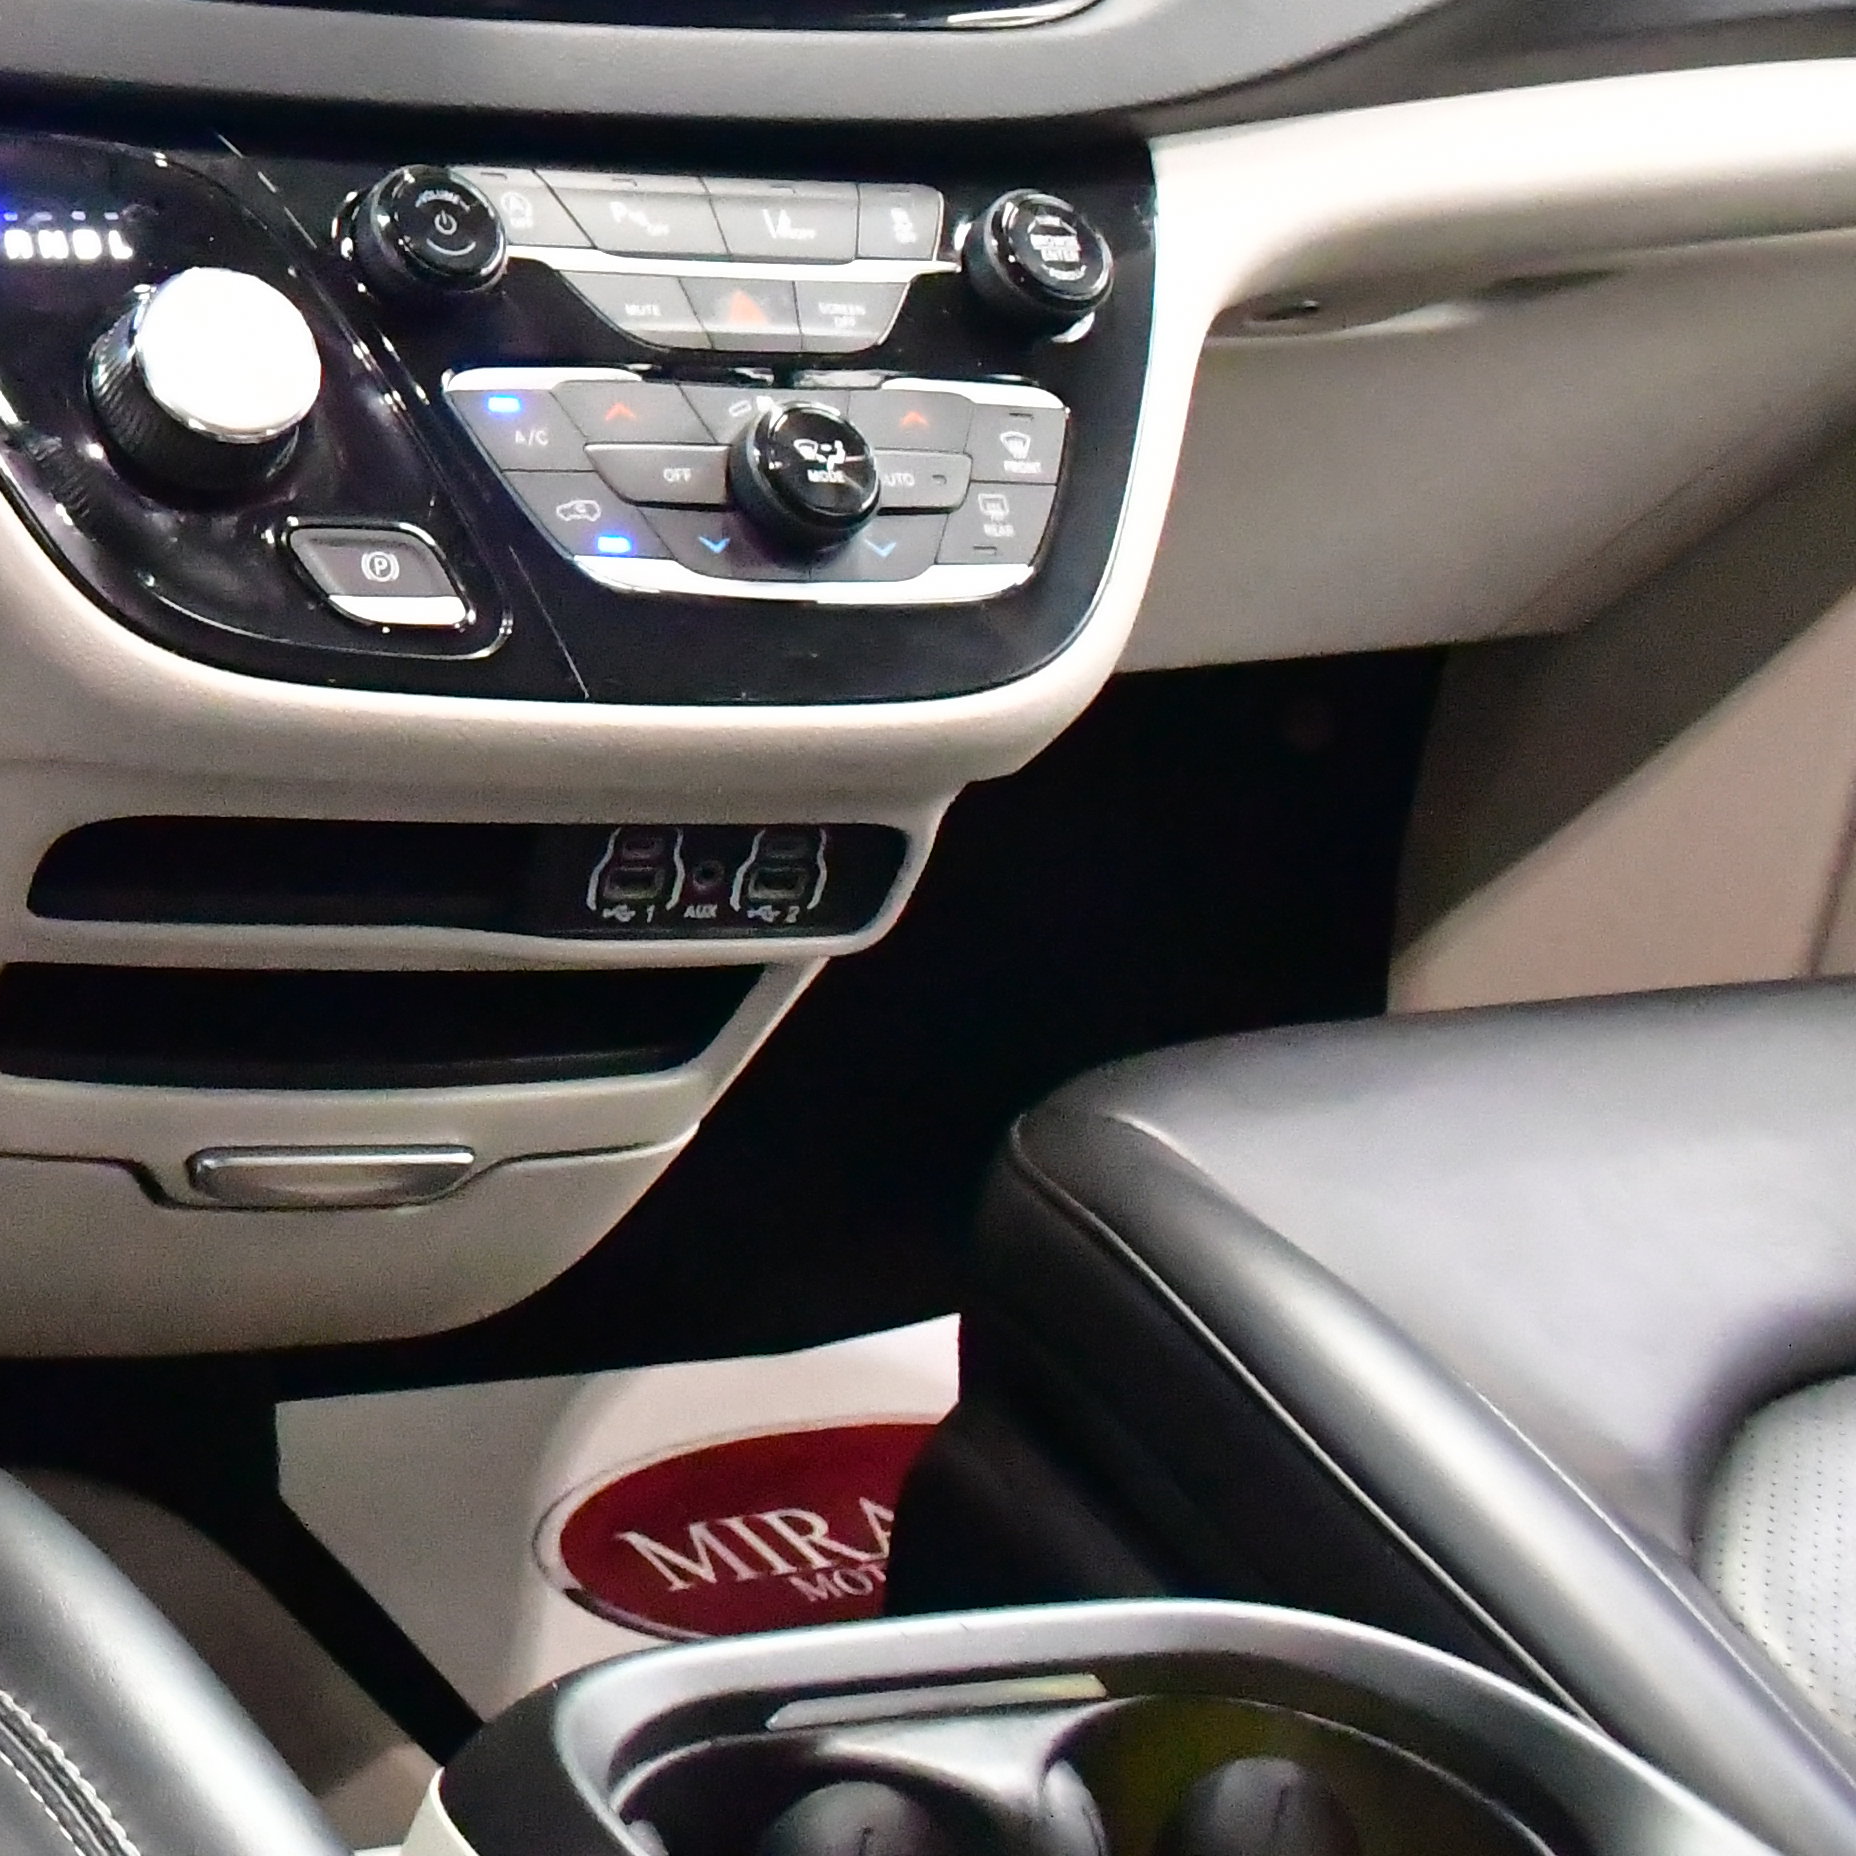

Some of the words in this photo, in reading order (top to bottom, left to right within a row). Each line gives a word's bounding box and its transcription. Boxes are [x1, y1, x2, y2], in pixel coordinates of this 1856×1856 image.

[108, 229, 133, 260] L
[514, 429, 549, 445] A/C
[663, 467, 693, 483] OFF
[807, 469, 845, 485] MODE
[646, 905, 655, 923] 1
[683, 904, 717, 919] AUX
[785, 906, 800, 923] 2
